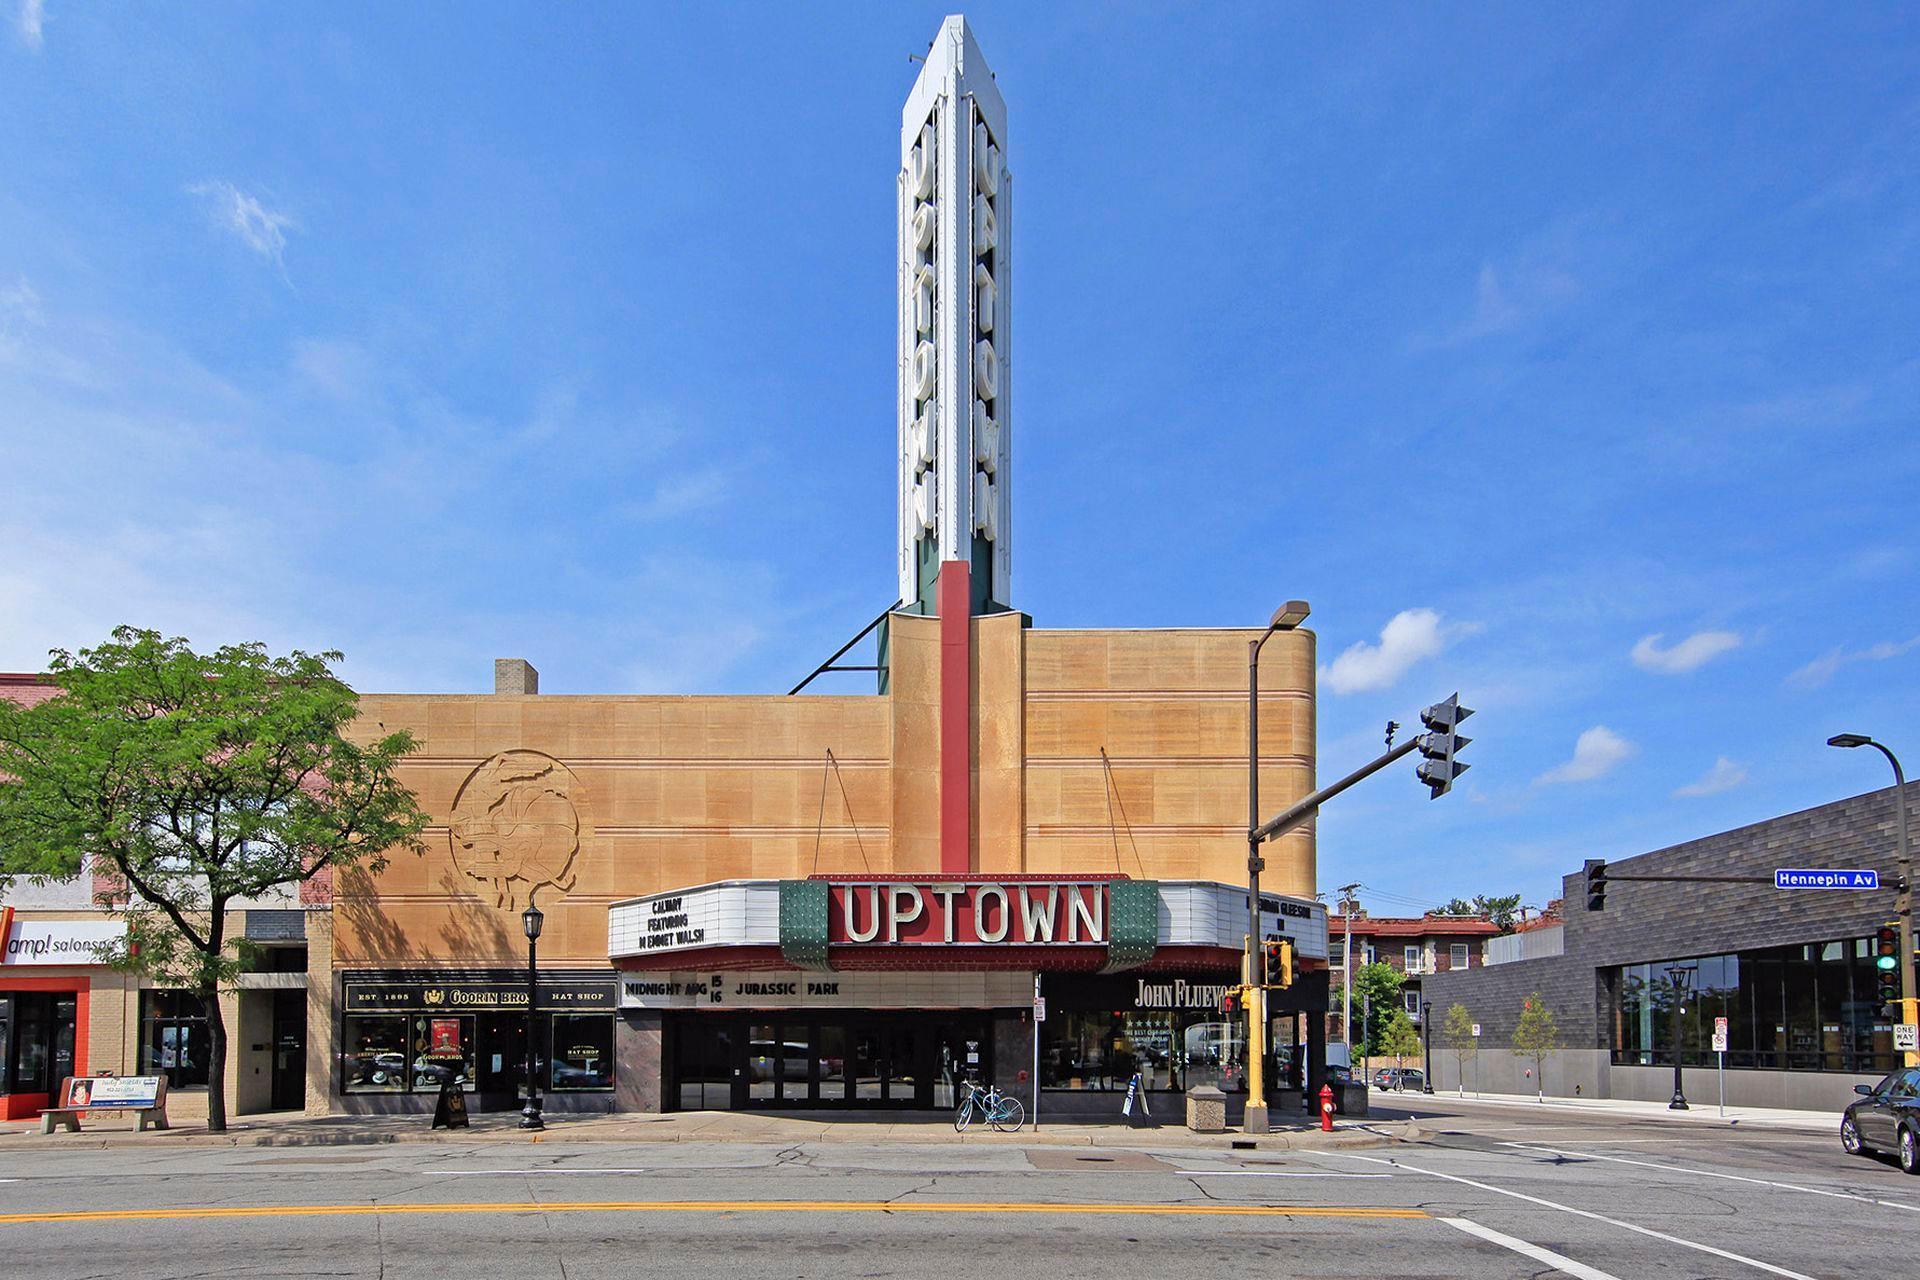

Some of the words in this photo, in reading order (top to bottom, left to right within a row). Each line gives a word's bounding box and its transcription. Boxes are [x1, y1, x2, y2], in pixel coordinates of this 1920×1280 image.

[1780, 873, 1848, 886] Hennepin
[1854, 874, 1873, 885] Av
[844, 884, 1103, 943] UPTOWN
[648, 913, 689, 933] FEATURING
[639, 936, 647, 949] M
[676, 928, 705, 944] WALSH
[8, 934, 51, 960] amp!
[625, 983, 681, 995] MIDNIGHT
[685, 983, 708, 995] AUG
[712, 976, 722, 987] 15
[736, 983, 796, 995] JURASSIC
[807, 983, 839, 995] PARK
[450, 989, 498, 1004] GOORIN
[711, 991, 722, 1003] 16
[1135, 979, 1173, 1007] JOHN
